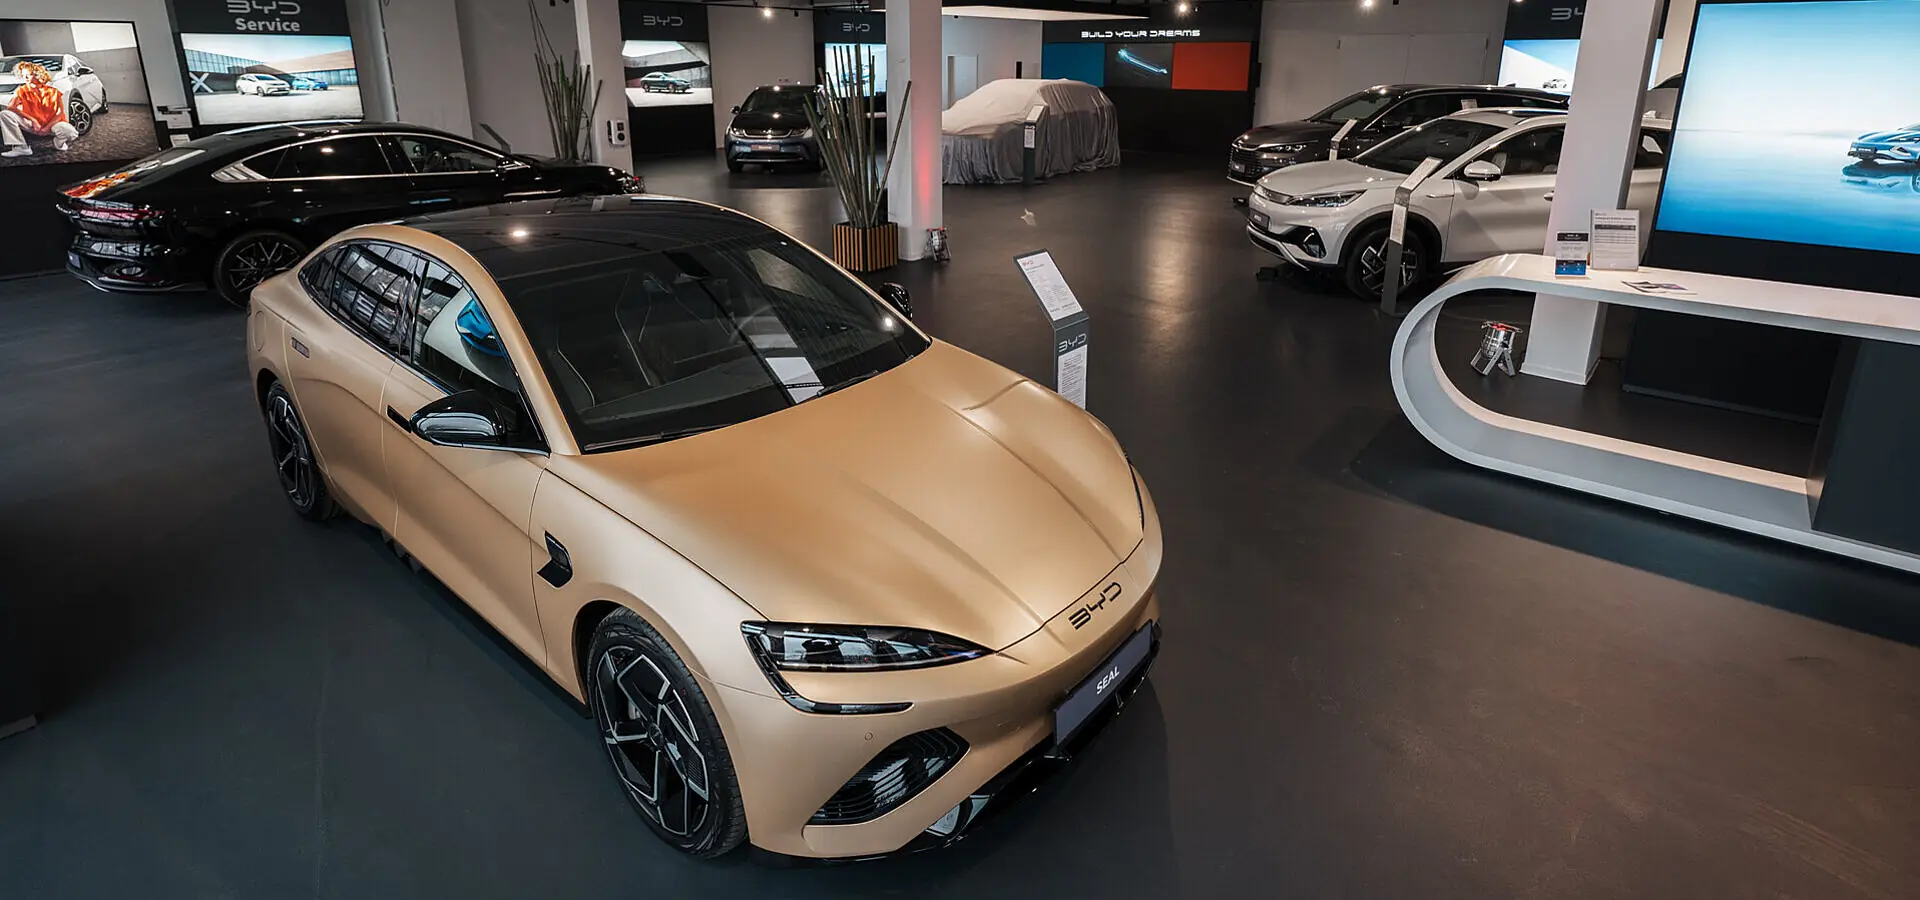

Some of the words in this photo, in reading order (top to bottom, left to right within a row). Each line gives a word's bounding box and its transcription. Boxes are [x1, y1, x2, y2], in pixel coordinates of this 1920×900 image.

[226, 0, 301, 14] BYD
[235, 18, 301, 32] Service
[643, 15, 683, 26] BYD
[1115, 30, 1147, 38] YOUR
[1149, 29, 1201, 37] DREAMS
[1058, 333, 1087, 352] BYD
[1068, 582, 1122, 630] BYD
[1096, 666, 1120, 695] SEAL
